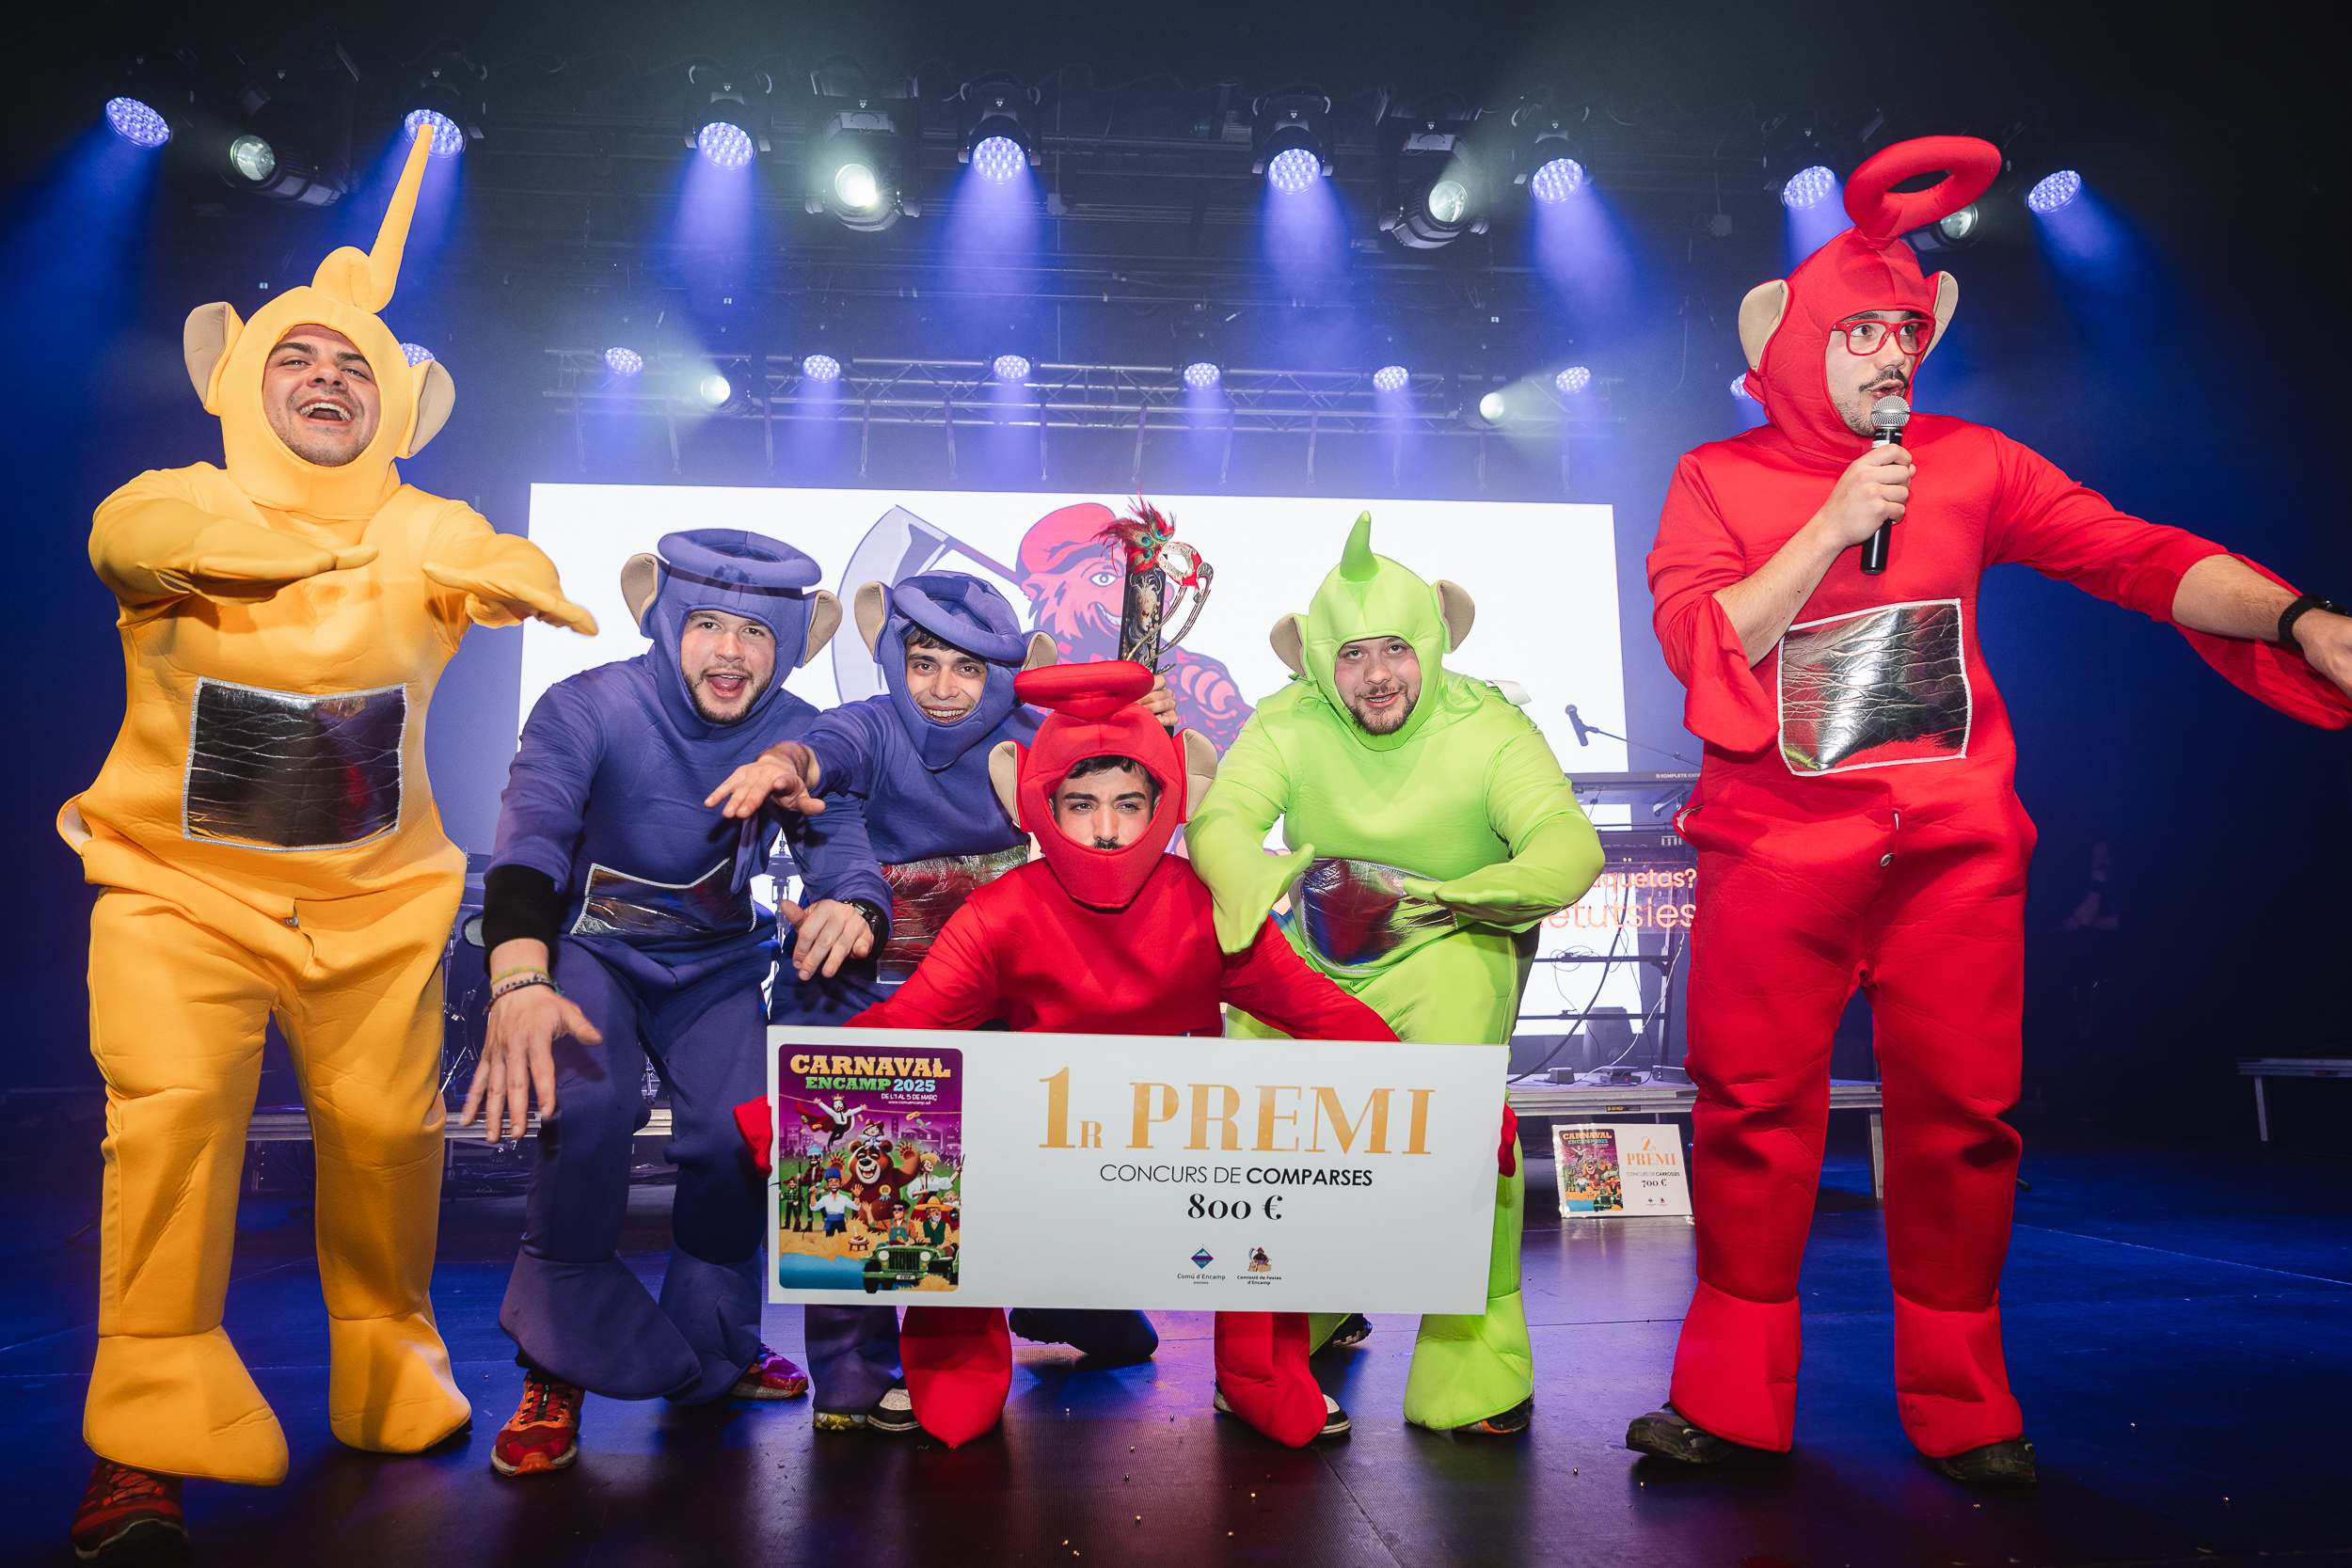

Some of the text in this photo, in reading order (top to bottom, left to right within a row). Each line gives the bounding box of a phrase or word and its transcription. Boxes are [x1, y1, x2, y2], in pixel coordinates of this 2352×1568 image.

[1540, 896, 1696, 927] etutsies
[790, 1054, 951, 1078] CARNAVAL
[805, 1076, 936, 1093] ENCAMP 2025
[1125, 1083, 1436, 1155] PREMI
[1563, 1132, 1613, 1140] CARNAVAL
[1627, 1153, 1677, 1165] PREMI
[1100, 1164, 1373, 1186] CONCURS DE COMPARSES
[1642, 1180, 1659, 1188] 700
[1187, 1193, 1283, 1220] 800 €
